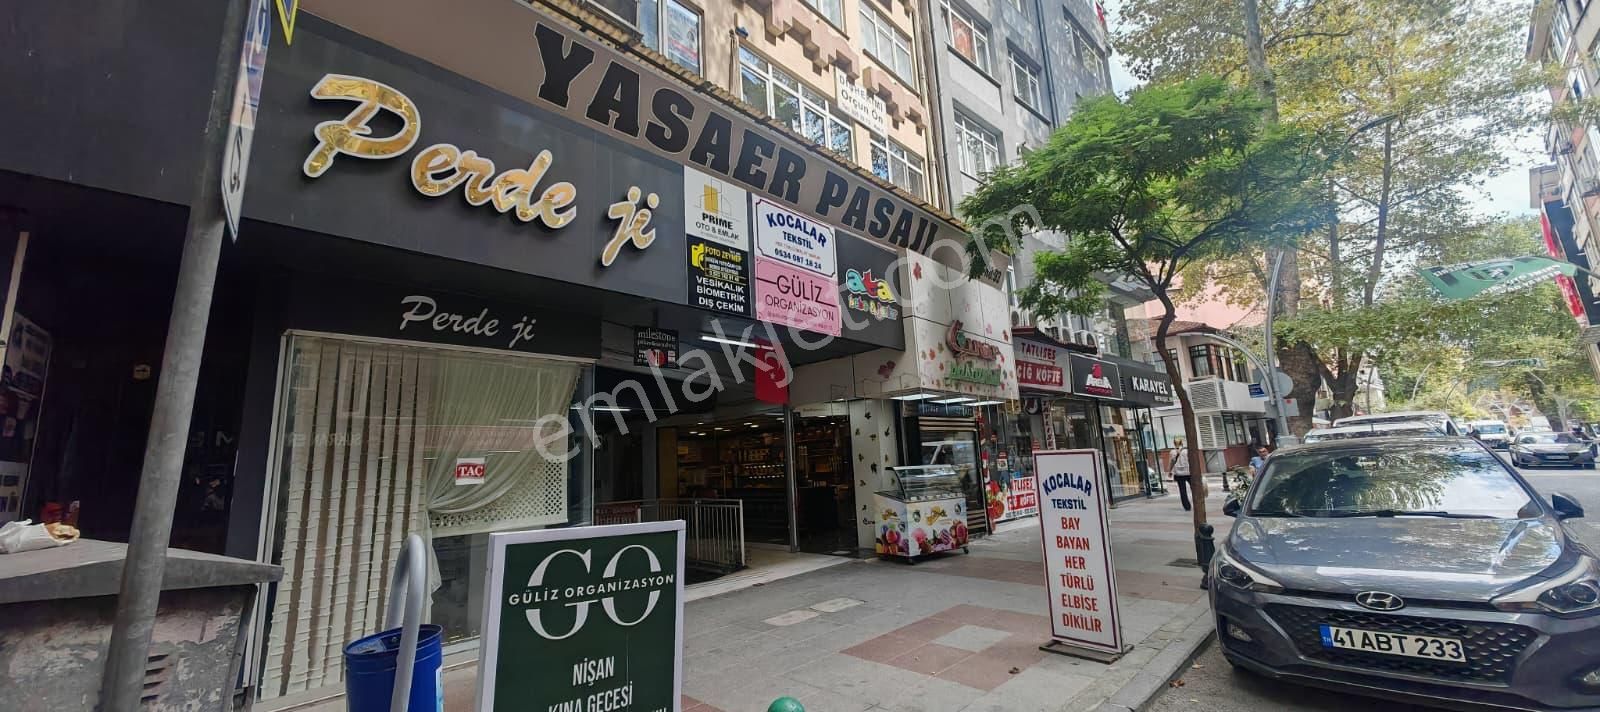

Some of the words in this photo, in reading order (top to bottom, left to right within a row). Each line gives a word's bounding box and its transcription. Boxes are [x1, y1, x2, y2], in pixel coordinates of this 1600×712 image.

[534, 21, 807, 205] YASAER
[303, 73, 577, 229] Perde
[601, 185, 660, 266] ji
[695, 221, 711, 231] OTO
[717, 229, 740, 240] EMLAK
[765, 212, 827, 247] KOCALAR
[782, 230, 814, 250] TEKSTİL
[705, 246, 721, 257] FOTO
[695, 275, 745, 294] VESİKALIK
[776, 274, 823, 303] GÜLİZ
[715, 300, 745, 313] ÇEKİM
[764, 294, 834, 321] ORGANİZASYON
[399, 295, 499, 337] Perde
[508, 315, 537, 349] ji
[1035, 365, 1061, 384] KÖFTE
[1131, 375, 1168, 395] KARAYEL
[457, 464, 485, 477] TAC
[1042, 472, 1093, 496] KOCALAR
[1050, 495, 1087, 511] TEKSTİL
[1060, 516, 1081, 531] BAY
[1056, 535, 1091, 551] BAYAN
[1064, 555, 1086, 570] HER
[508, 586, 560, 605] GÜLİZ
[564, 574, 675, 599] ORGANİZASYON
[1059, 572, 1095, 591] TÜRLÜ
[1061, 593, 1099, 612] ELBİSE
[1061, 611, 1103, 633] DİKİLİR
[1333, 628, 1356, 648] 41
[1360, 631, 1408, 654] ABT
[1414, 637, 1463, 660] 233
[572, 655, 615, 687] NİŞAN
[586, 680, 633, 712] GECESİ
